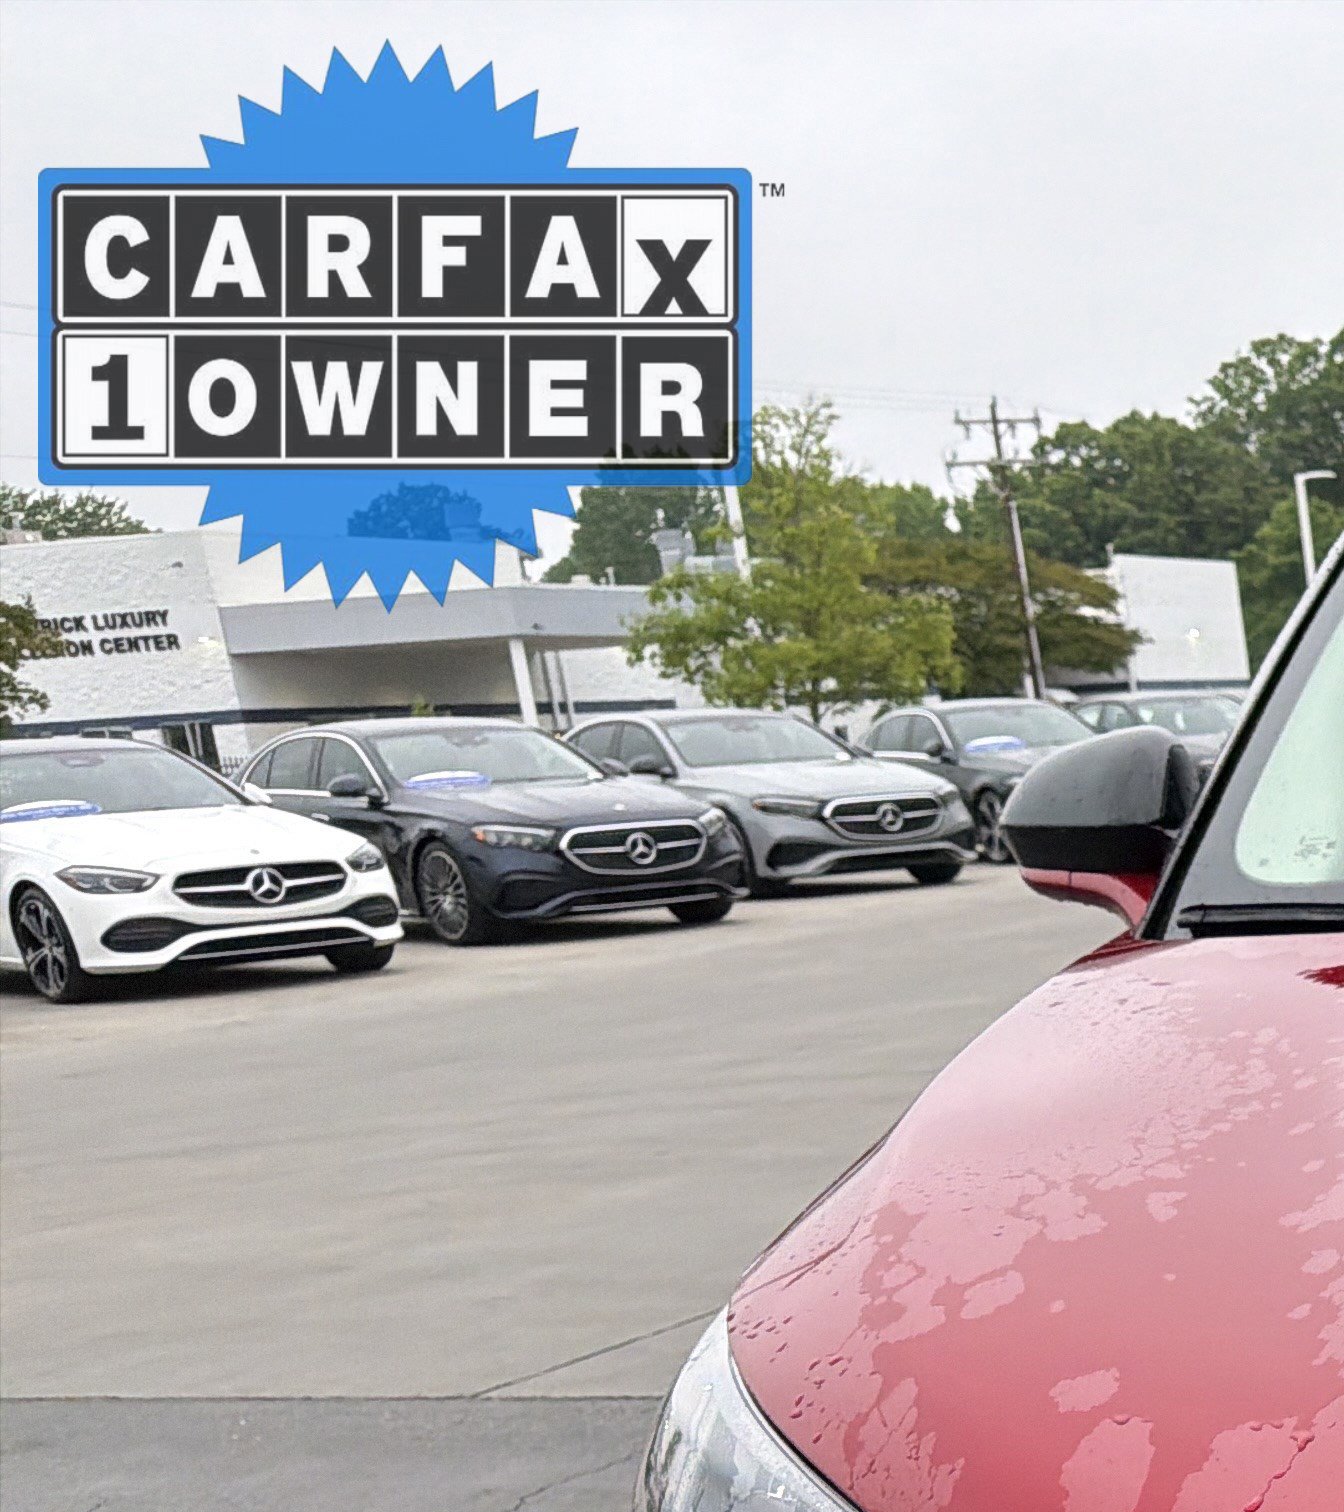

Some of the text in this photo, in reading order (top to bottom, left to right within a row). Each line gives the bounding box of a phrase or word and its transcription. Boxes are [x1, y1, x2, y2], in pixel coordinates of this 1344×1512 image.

[37, 609, 170, 634] RICK LUXURY
[99, 633, 181, 655] CENTER
